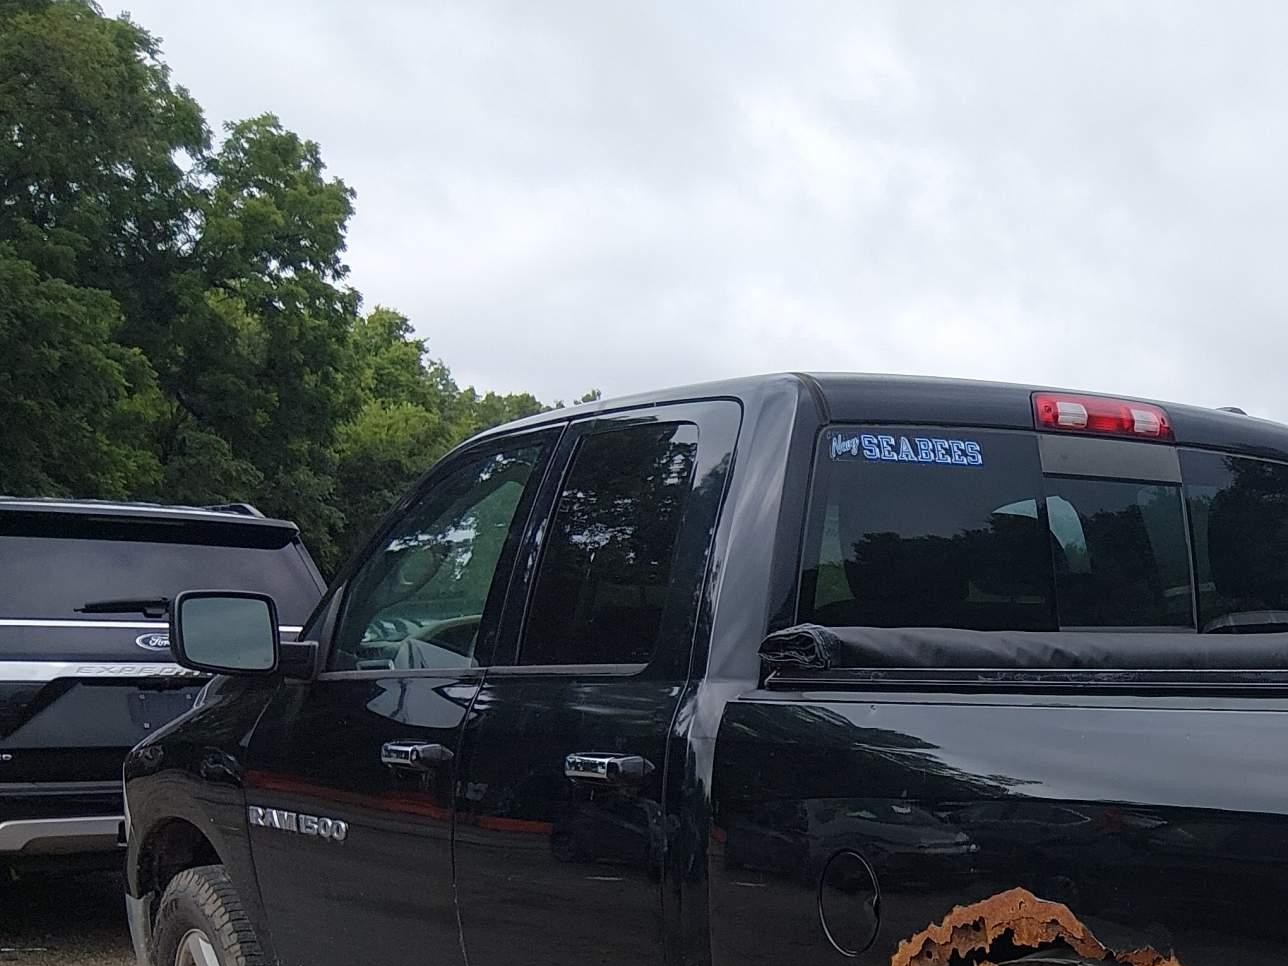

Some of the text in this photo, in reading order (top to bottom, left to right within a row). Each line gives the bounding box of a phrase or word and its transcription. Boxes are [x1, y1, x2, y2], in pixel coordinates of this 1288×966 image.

[860, 434, 984, 466] SEABEES
[248, 805, 347, 841] RAM 1500
